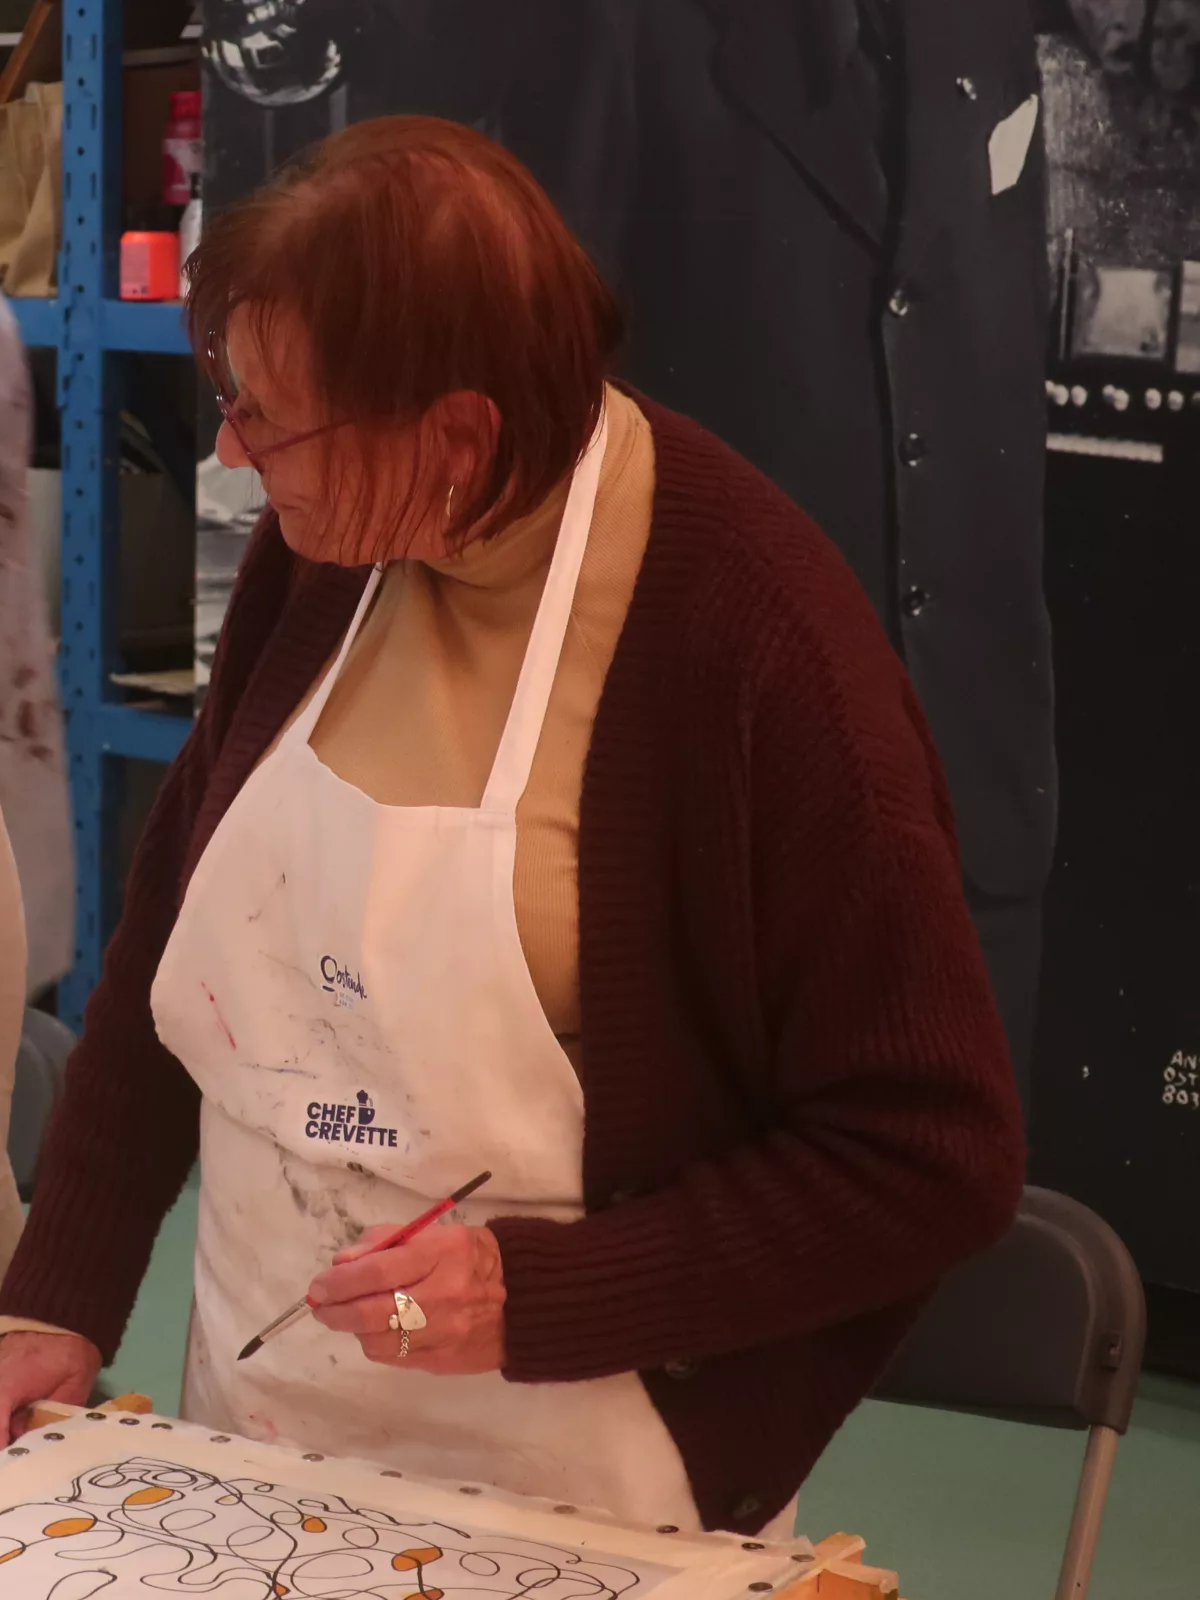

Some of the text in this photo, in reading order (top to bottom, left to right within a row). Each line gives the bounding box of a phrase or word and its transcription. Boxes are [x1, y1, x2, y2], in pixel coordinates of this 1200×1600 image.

[1170, 1050, 1200, 1070] AN
[307, 1102, 356, 1123] CHEF
[305, 1120, 398, 1147] CREVETTE
